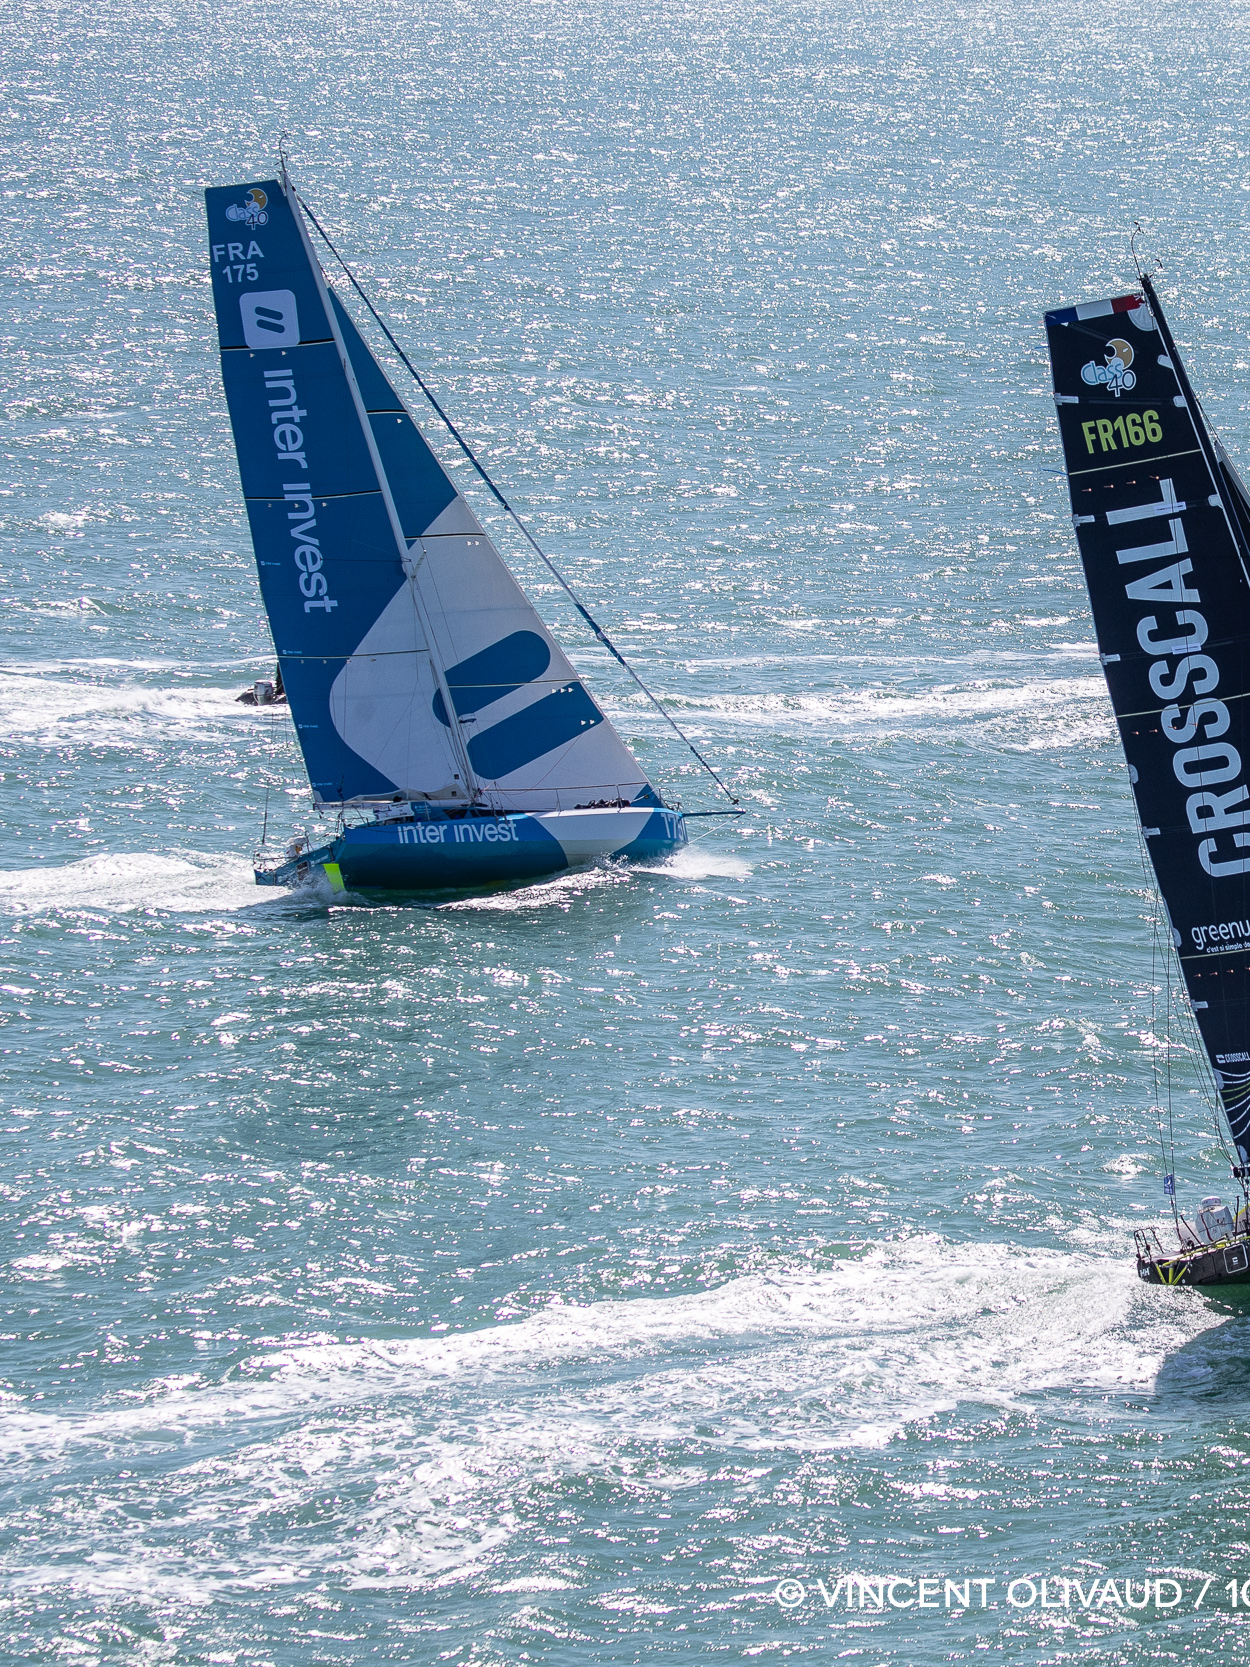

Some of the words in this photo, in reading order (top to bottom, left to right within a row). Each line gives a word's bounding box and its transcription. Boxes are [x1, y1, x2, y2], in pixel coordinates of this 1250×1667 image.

[225, 203, 260, 222] Class
[245, 210, 269, 230] 40
[212, 240, 265, 263] FRA
[222, 262, 259, 283] 175
[1081, 360, 1125, 386] Class
[1106, 369, 1137, 398] 40
[263, 369, 308, 469] inter
[1081, 409, 1164, 455] FR166
[282, 482, 338, 613] invest
[397, 821, 448, 844] inter
[453, 819, 519, 842] invest
